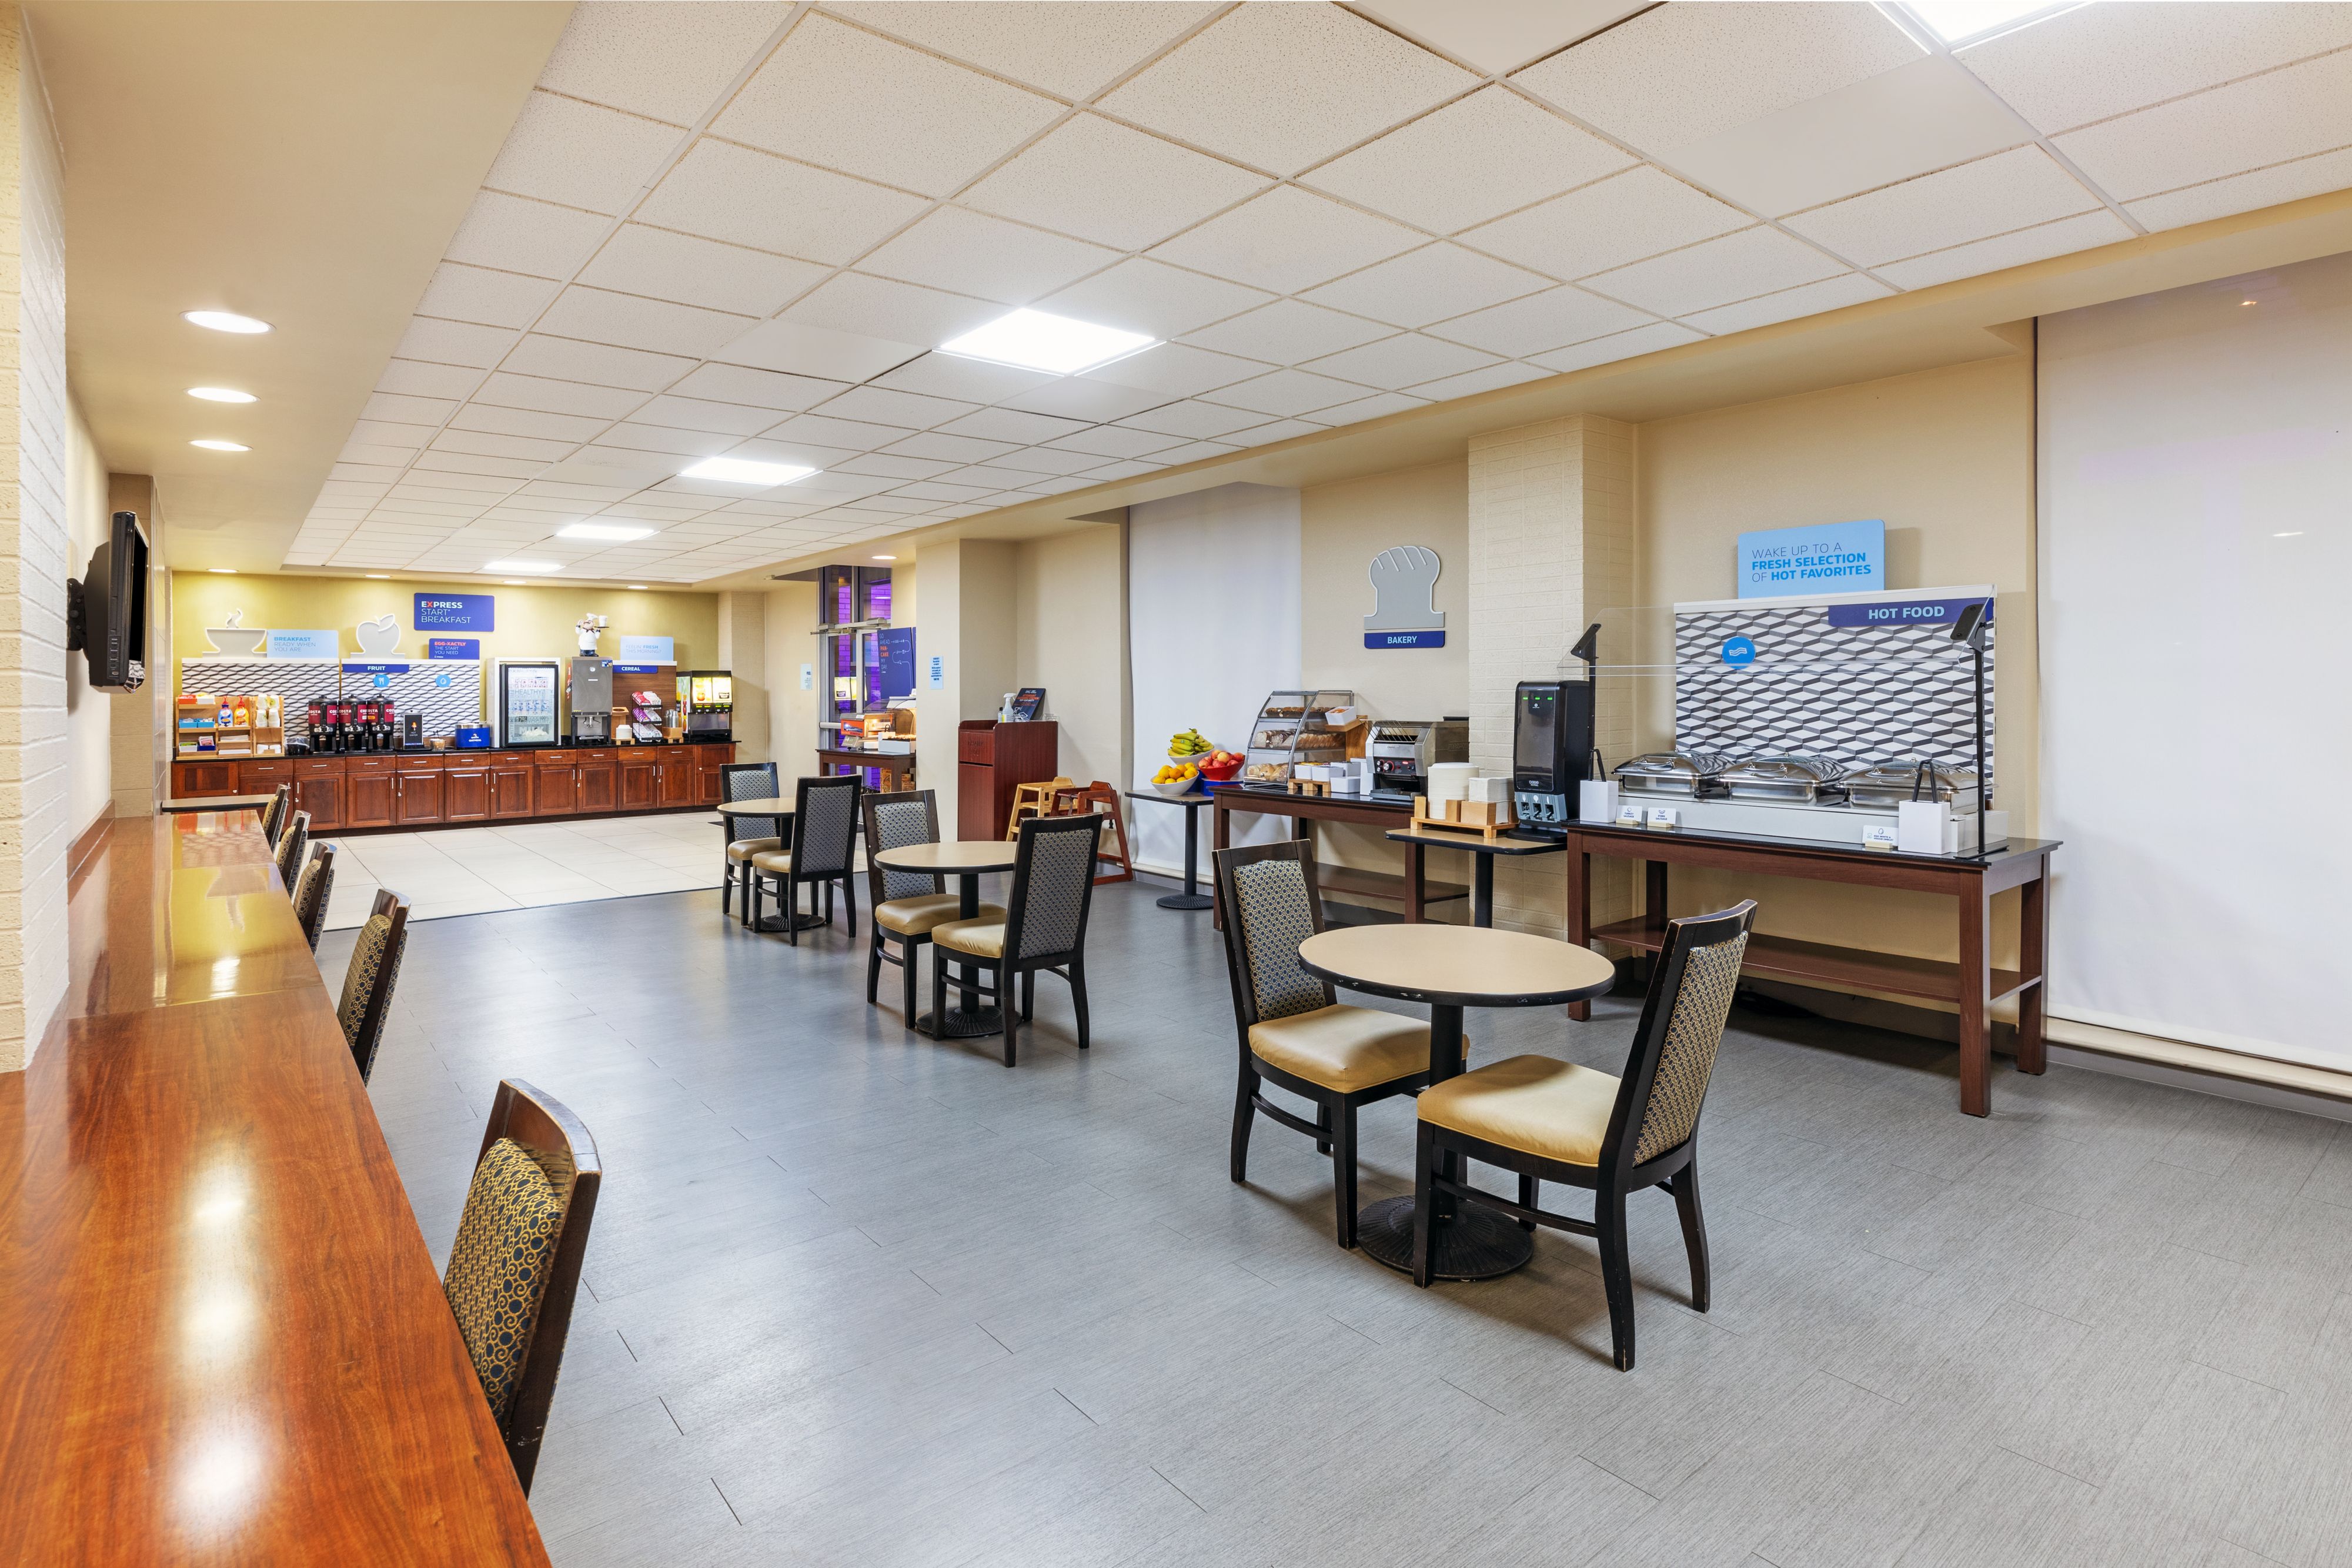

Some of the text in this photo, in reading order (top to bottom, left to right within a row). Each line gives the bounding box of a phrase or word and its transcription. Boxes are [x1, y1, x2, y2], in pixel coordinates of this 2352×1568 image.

[1752, 542, 1842, 559] WAKE UP TO A
[1752, 552, 1866, 570] FRESH SELECTION
[1752, 564, 1872, 583] OF HOT FAVORITES
[1869, 606, 1945, 619] HOT FOOD
